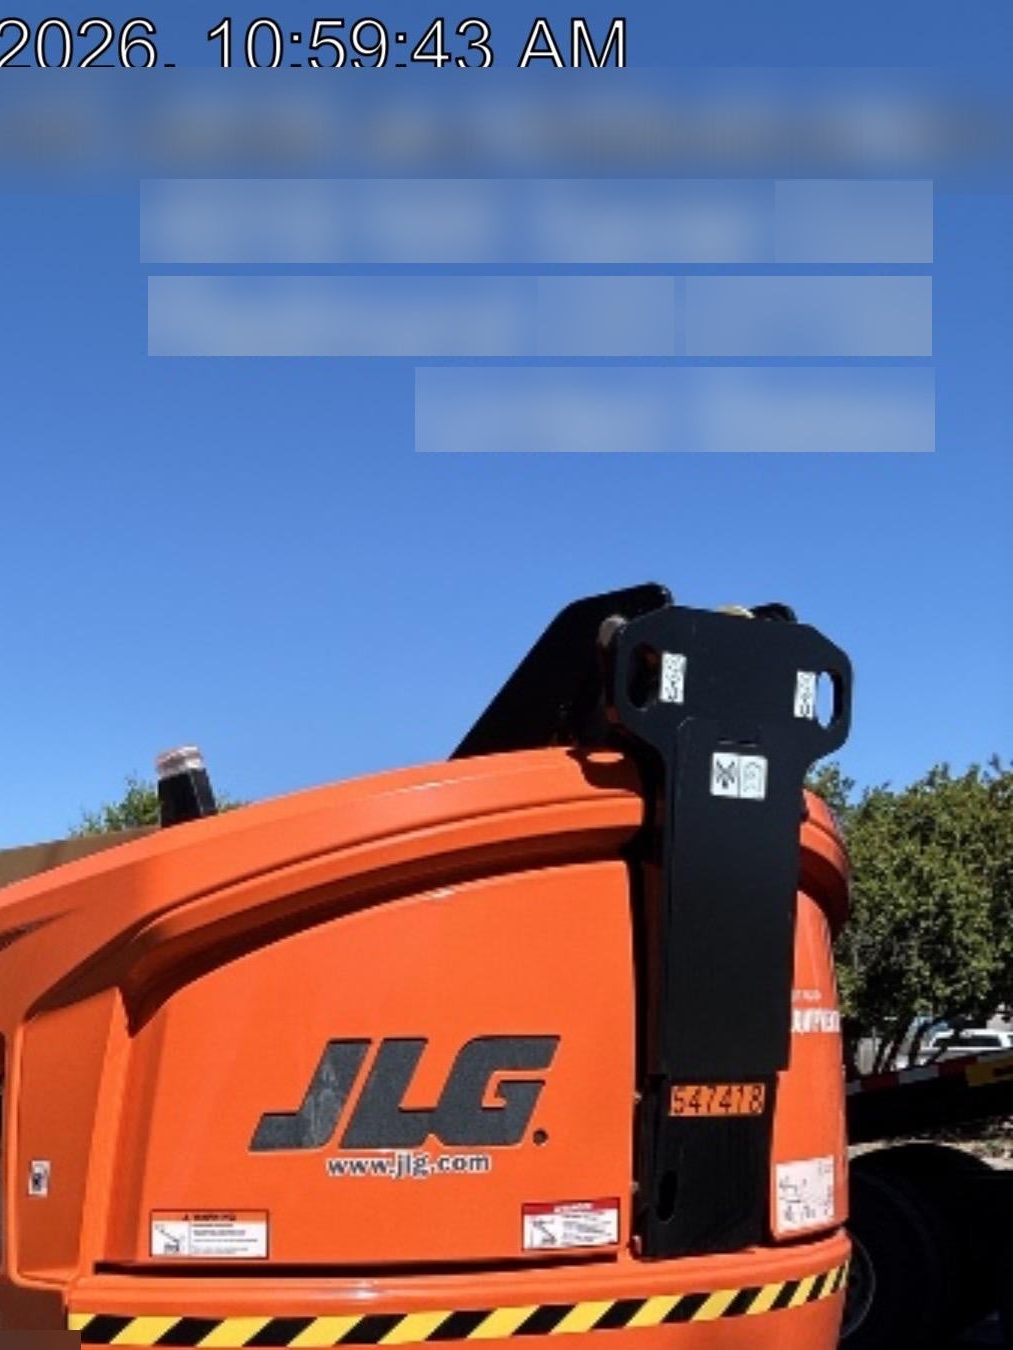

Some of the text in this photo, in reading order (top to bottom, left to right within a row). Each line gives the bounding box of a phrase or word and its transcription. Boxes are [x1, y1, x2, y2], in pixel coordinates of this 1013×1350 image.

[249, 1035, 561, 1151] JLG
[673, 1085, 763, 1114] 547418
[327, 1152, 490, 1178] www.jlg.com
